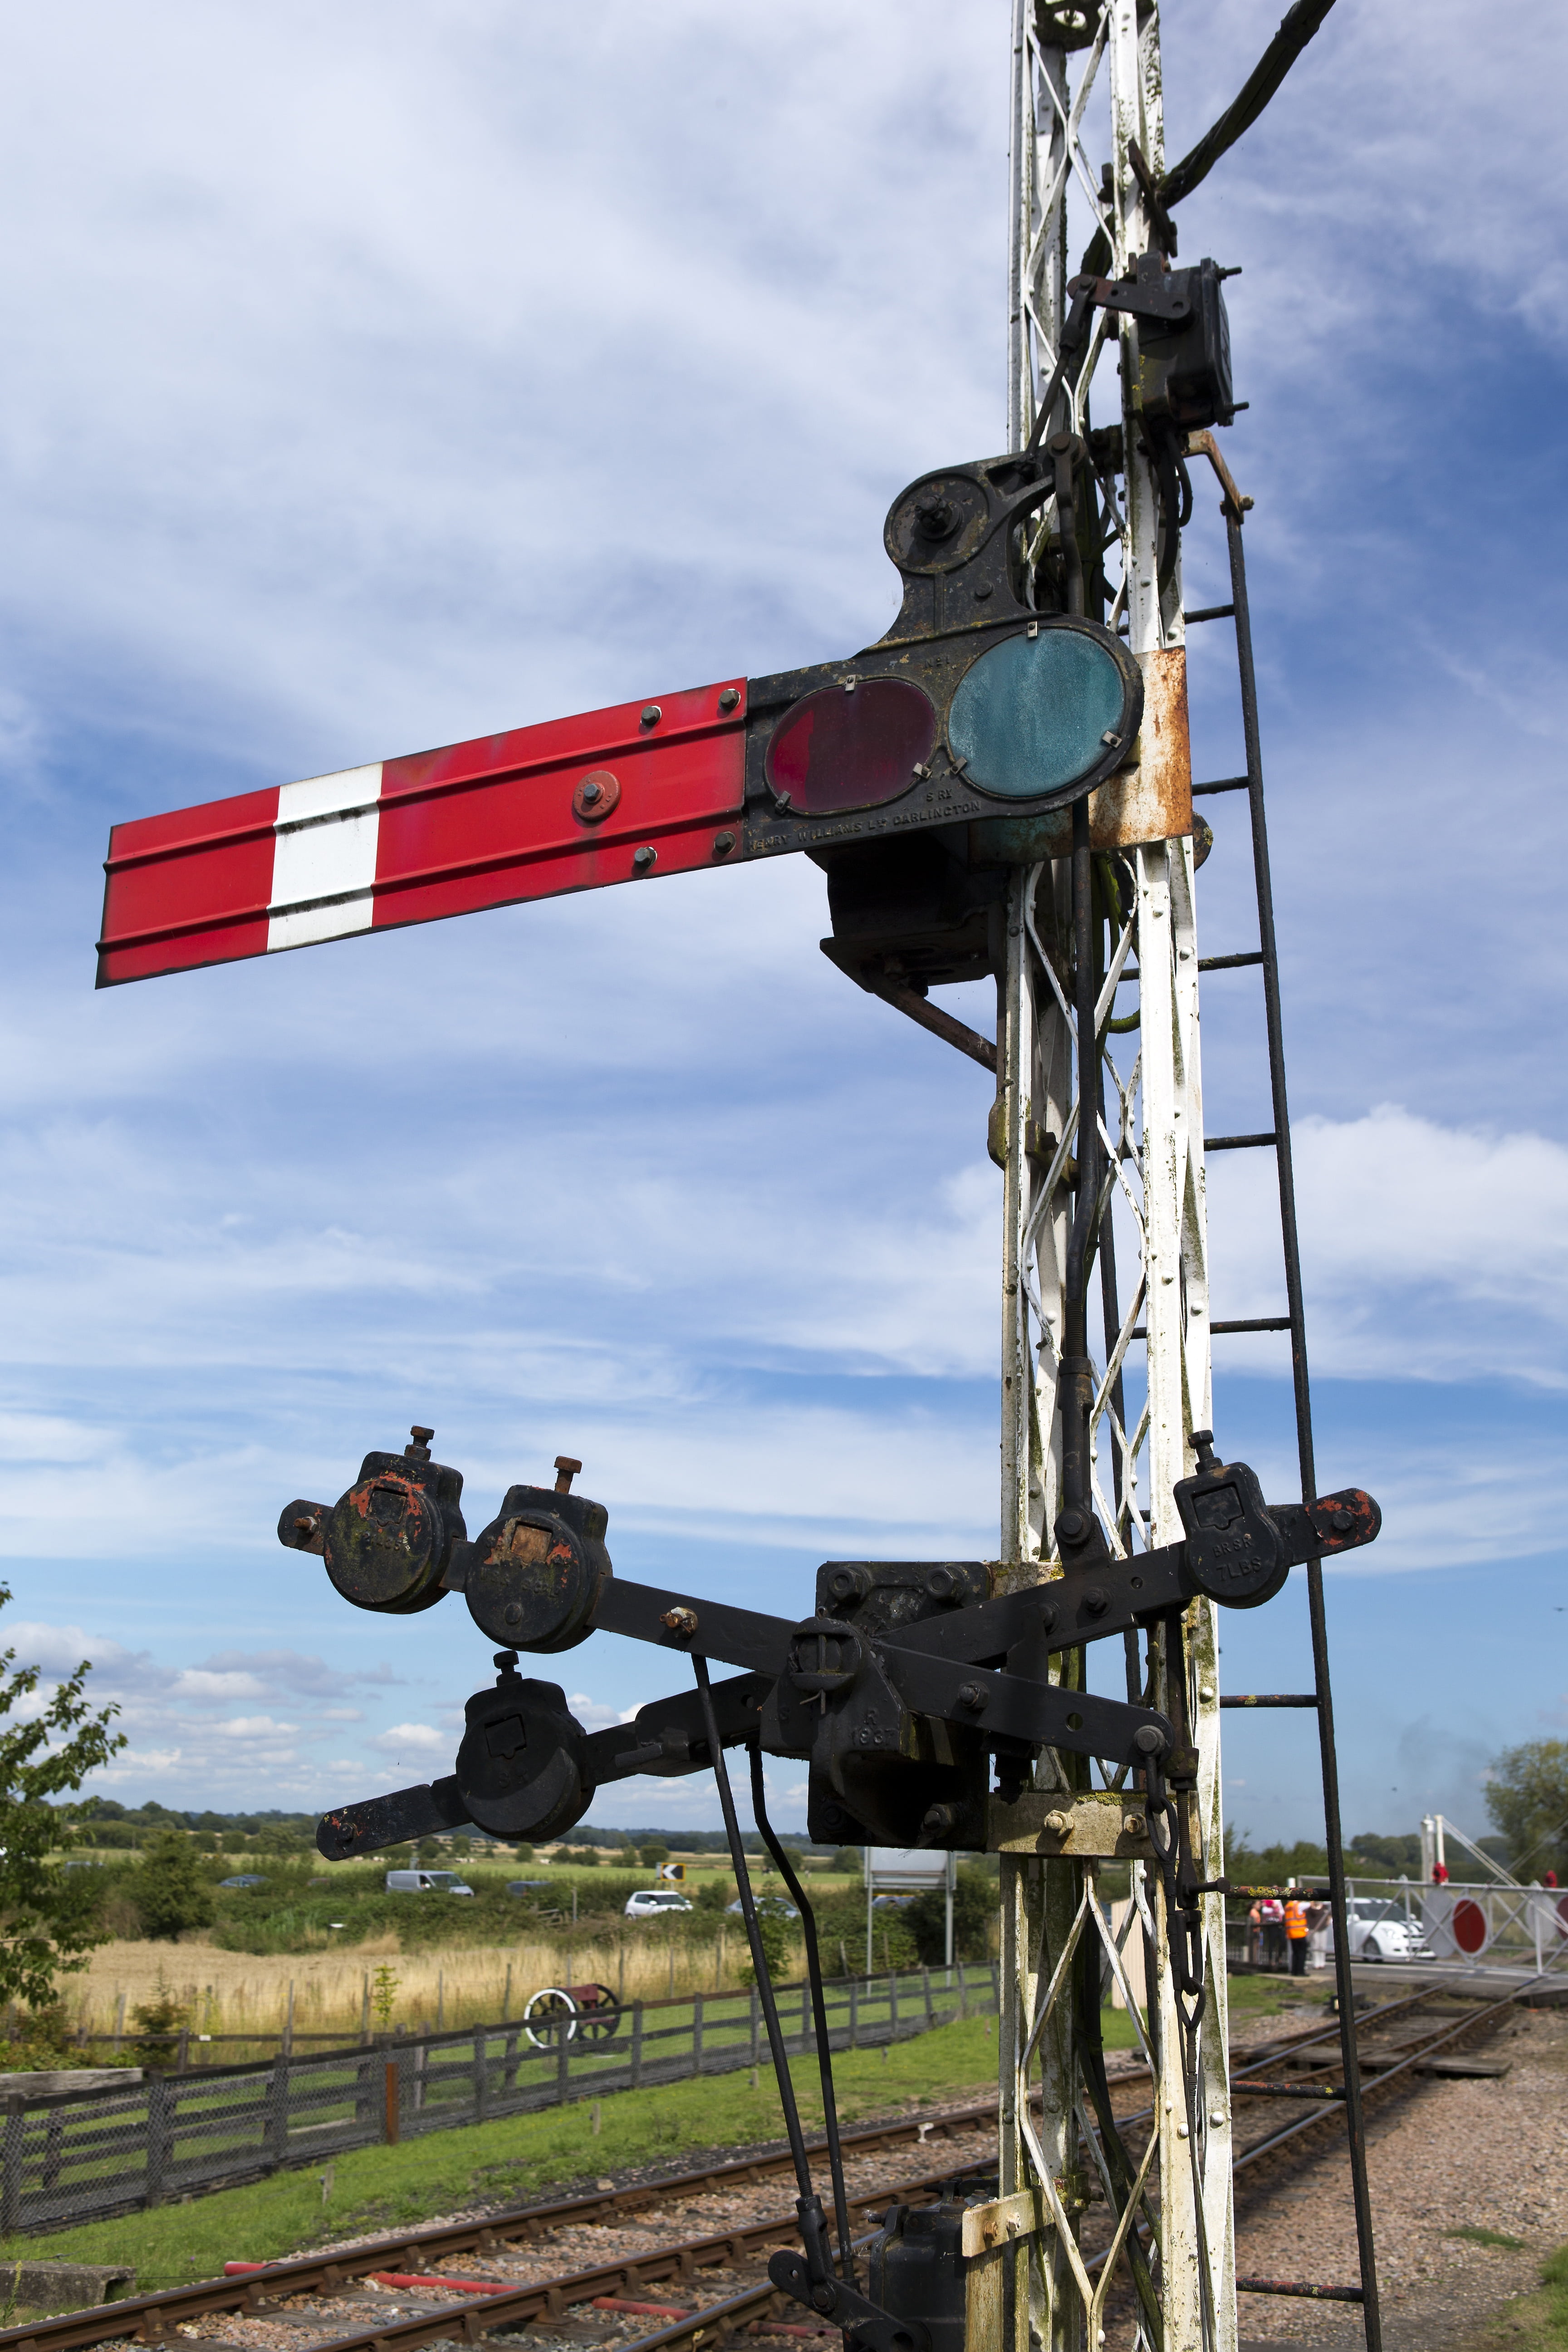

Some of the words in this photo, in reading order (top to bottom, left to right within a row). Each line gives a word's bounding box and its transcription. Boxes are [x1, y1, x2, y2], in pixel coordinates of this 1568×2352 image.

[748, 835, 788, 852] HENRY
[798, 822, 863, 842] WILLIAMS
[893, 800, 982, 825] DARLINGTON
